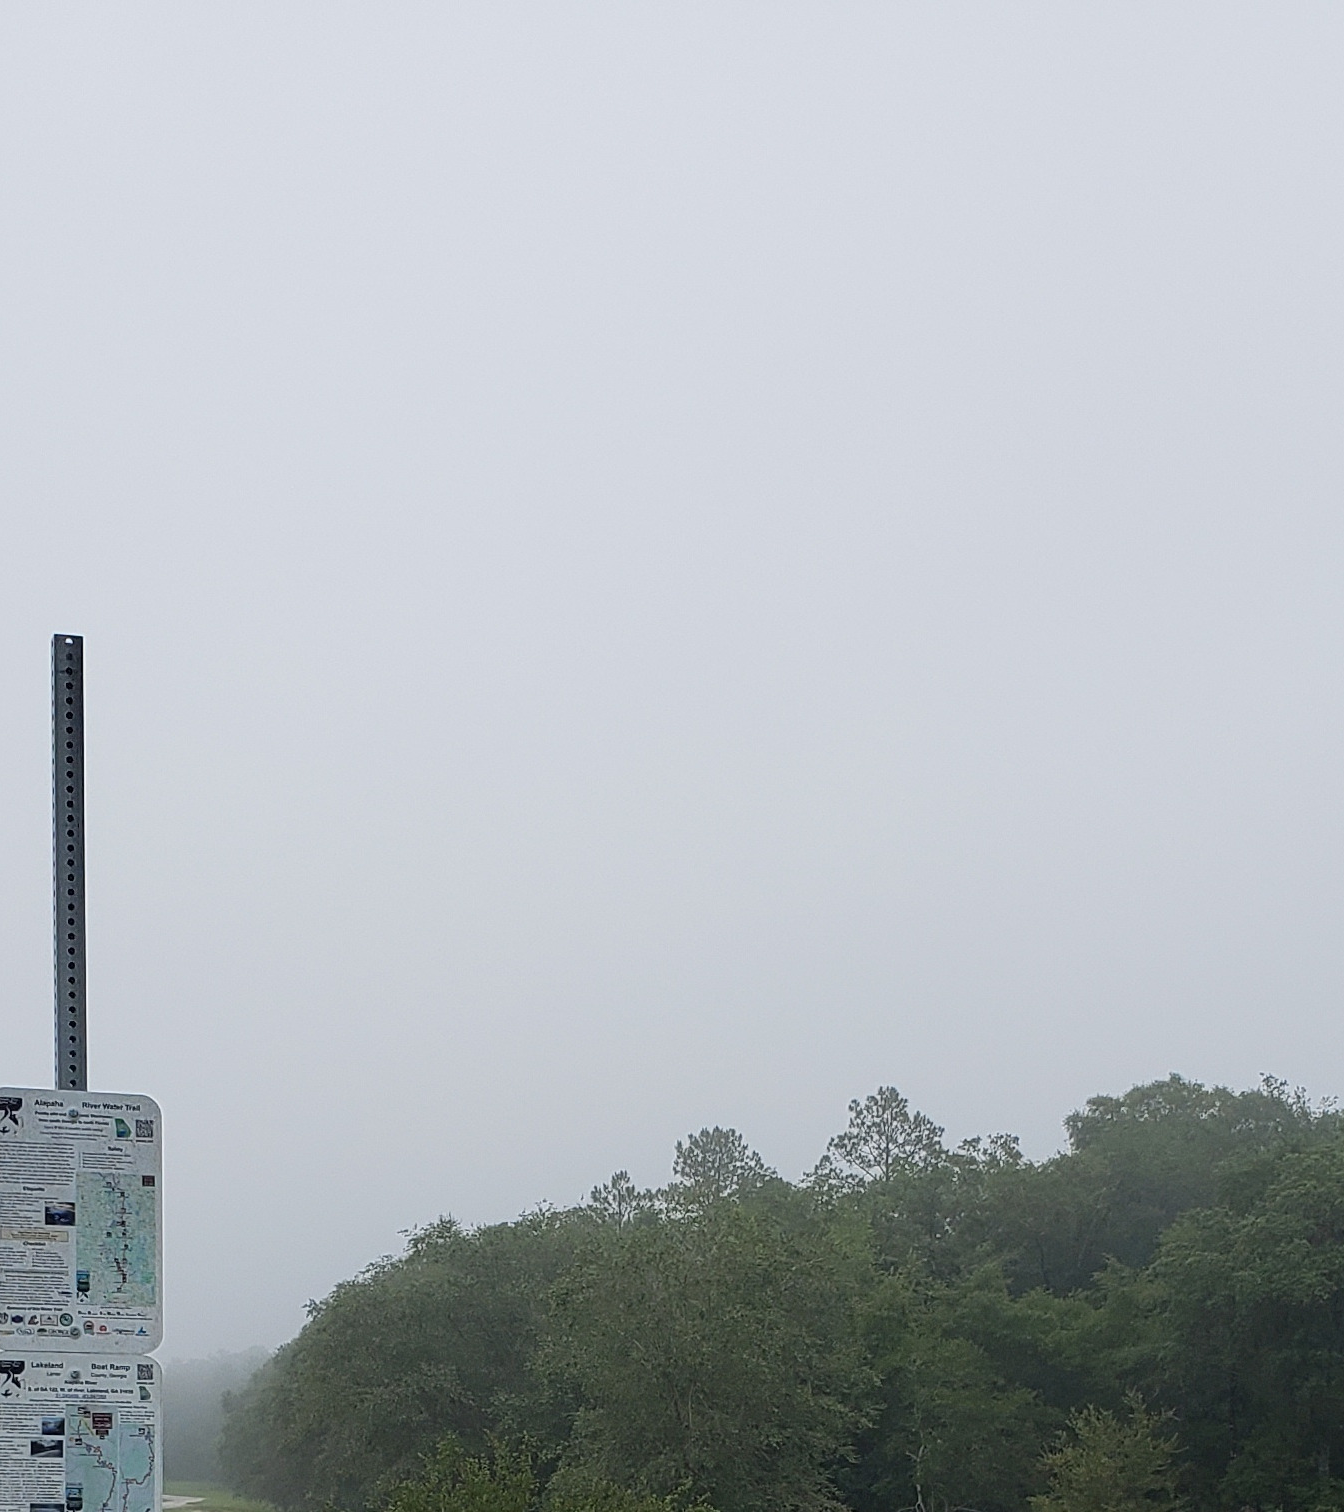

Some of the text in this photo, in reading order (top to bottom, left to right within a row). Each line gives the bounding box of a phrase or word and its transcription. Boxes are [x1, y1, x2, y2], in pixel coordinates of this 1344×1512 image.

[34, 1099, 64, 1108] Alapaha
[82, 1101, 101, 1109] River
[102, 1102, 123, 1110] Water
[124, 1104, 141, 1112] Trail
[31, 1361, 64, 1369] Lakeland
